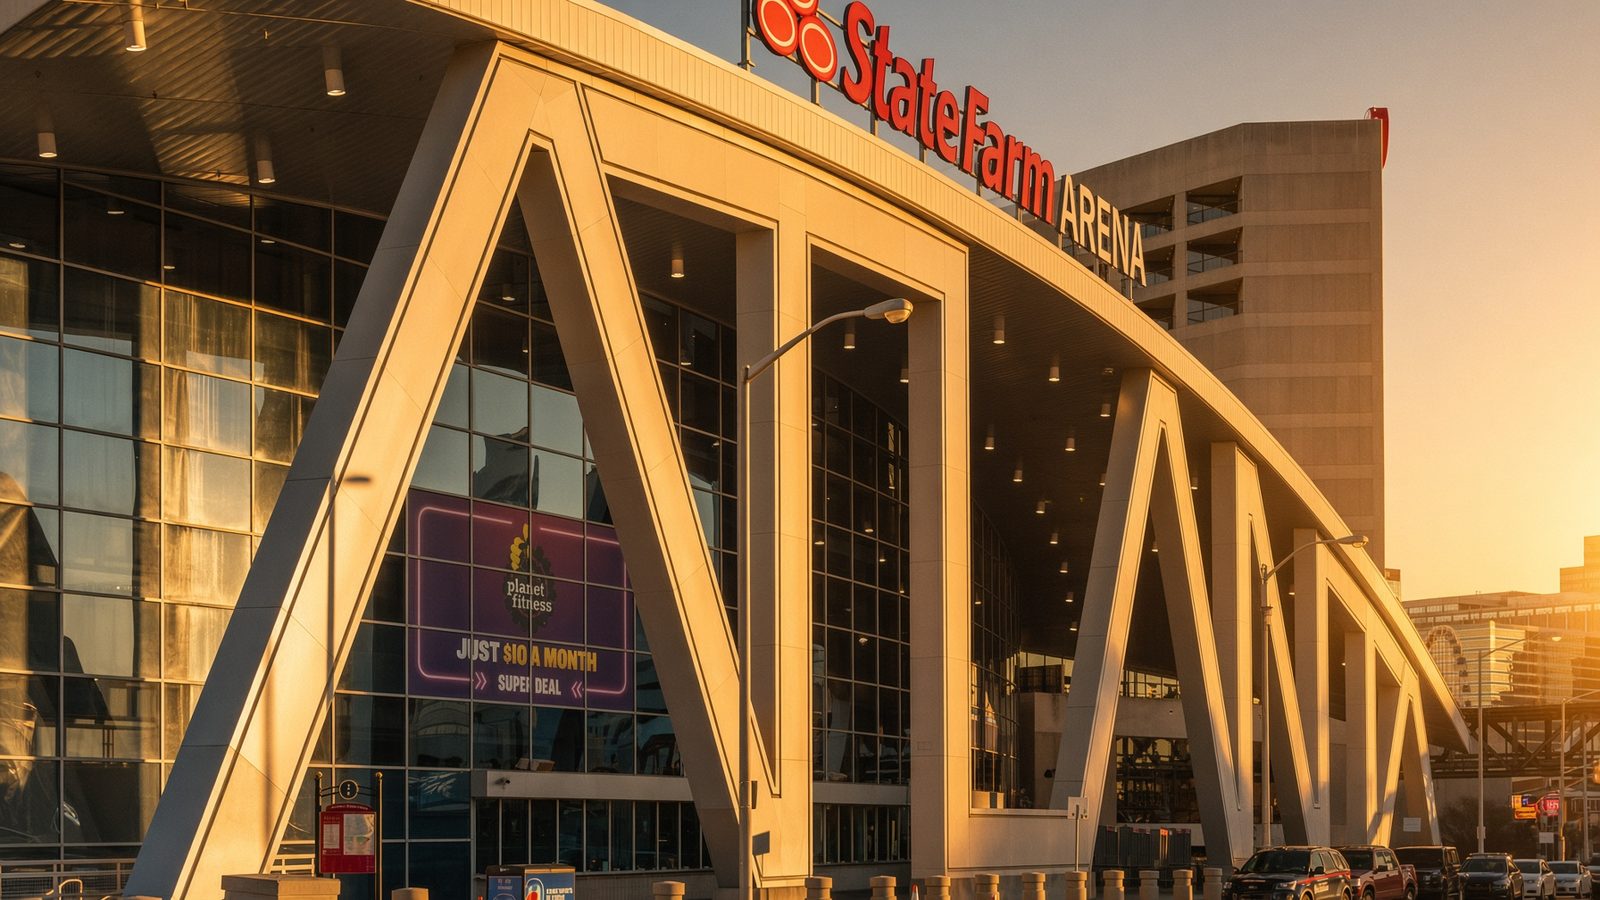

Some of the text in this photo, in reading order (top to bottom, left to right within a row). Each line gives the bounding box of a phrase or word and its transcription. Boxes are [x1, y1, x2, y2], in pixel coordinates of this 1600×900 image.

[1059, 174, 1147, 287] ARENA
[507, 578, 545, 597] planet
[512, 594, 552, 612] fitness
[456, 637, 597, 672] JUST $10 A MONTH
[535, 677, 561, 696] DEAL
